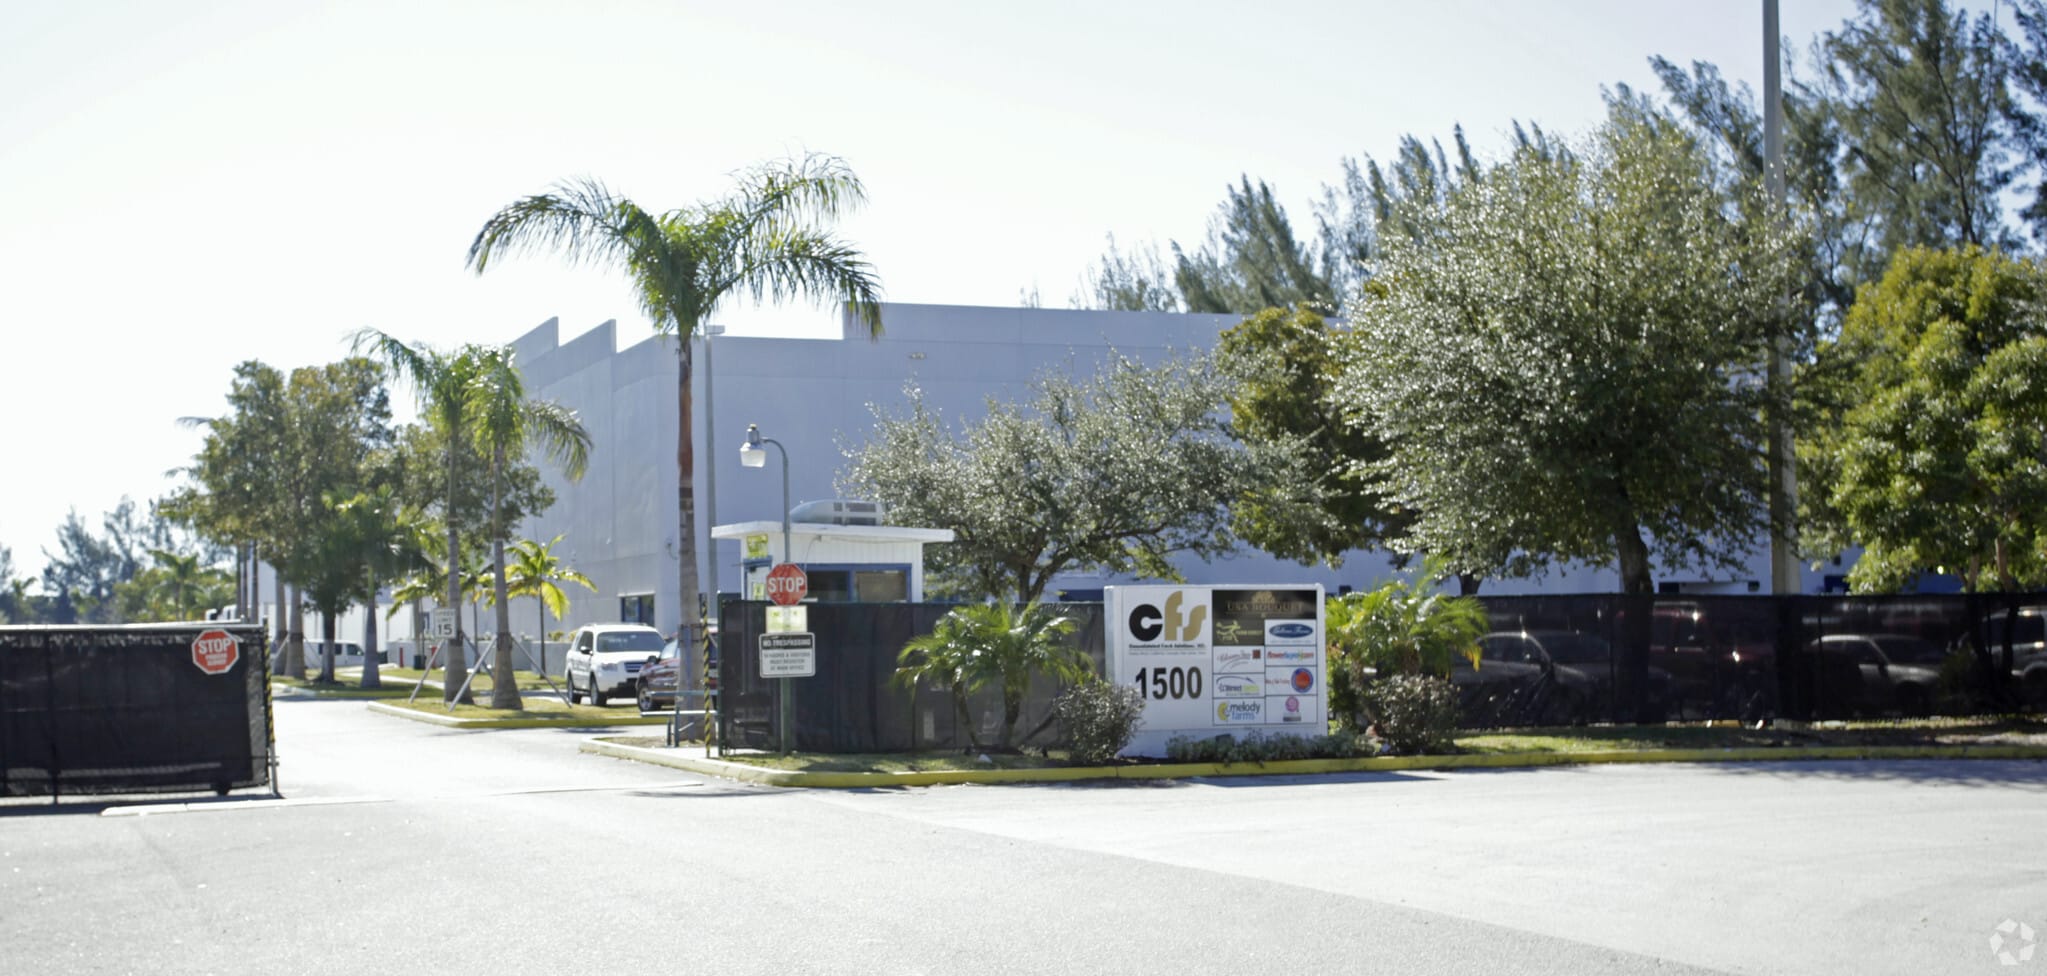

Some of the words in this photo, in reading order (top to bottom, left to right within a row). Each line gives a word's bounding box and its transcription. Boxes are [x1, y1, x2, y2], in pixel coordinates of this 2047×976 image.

[767, 577, 805, 593] STOP
[1252, 601, 1304, 612] BOUQUET
[1129, 591, 1207, 642] cfs
[438, 624, 453, 635] 15
[198, 638, 232, 655] STOP
[1136, 667, 1202, 699] 1500
[1230, 701, 1260, 714] melody
[1231, 711, 1256, 721] farms
